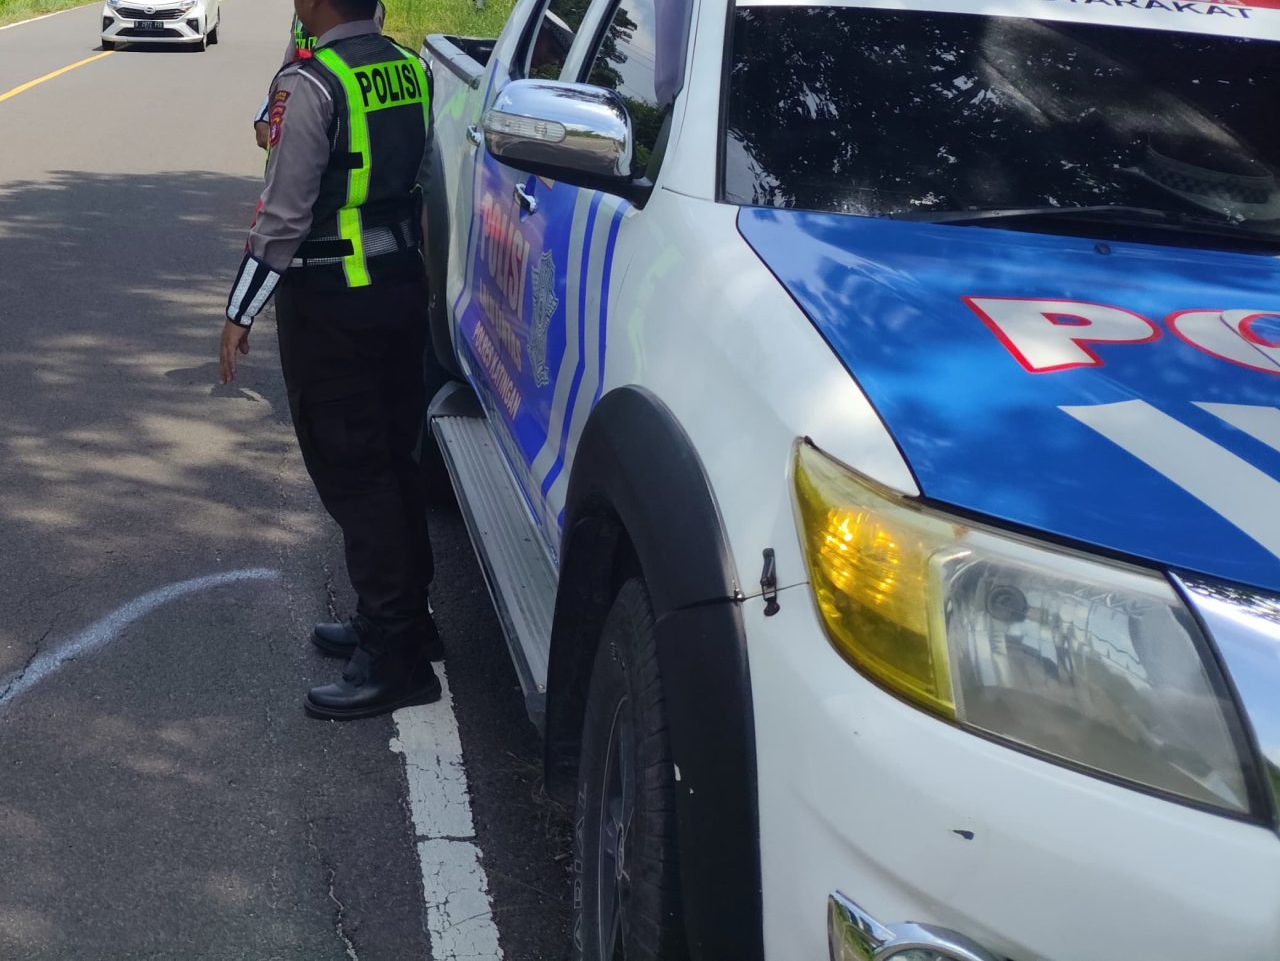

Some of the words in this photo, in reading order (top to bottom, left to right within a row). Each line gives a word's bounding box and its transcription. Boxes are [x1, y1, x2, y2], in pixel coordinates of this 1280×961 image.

[353, 63, 422, 107] POLISI
[480, 190, 530, 321] POLISI
[488, 356, 522, 421] KATINGAN
